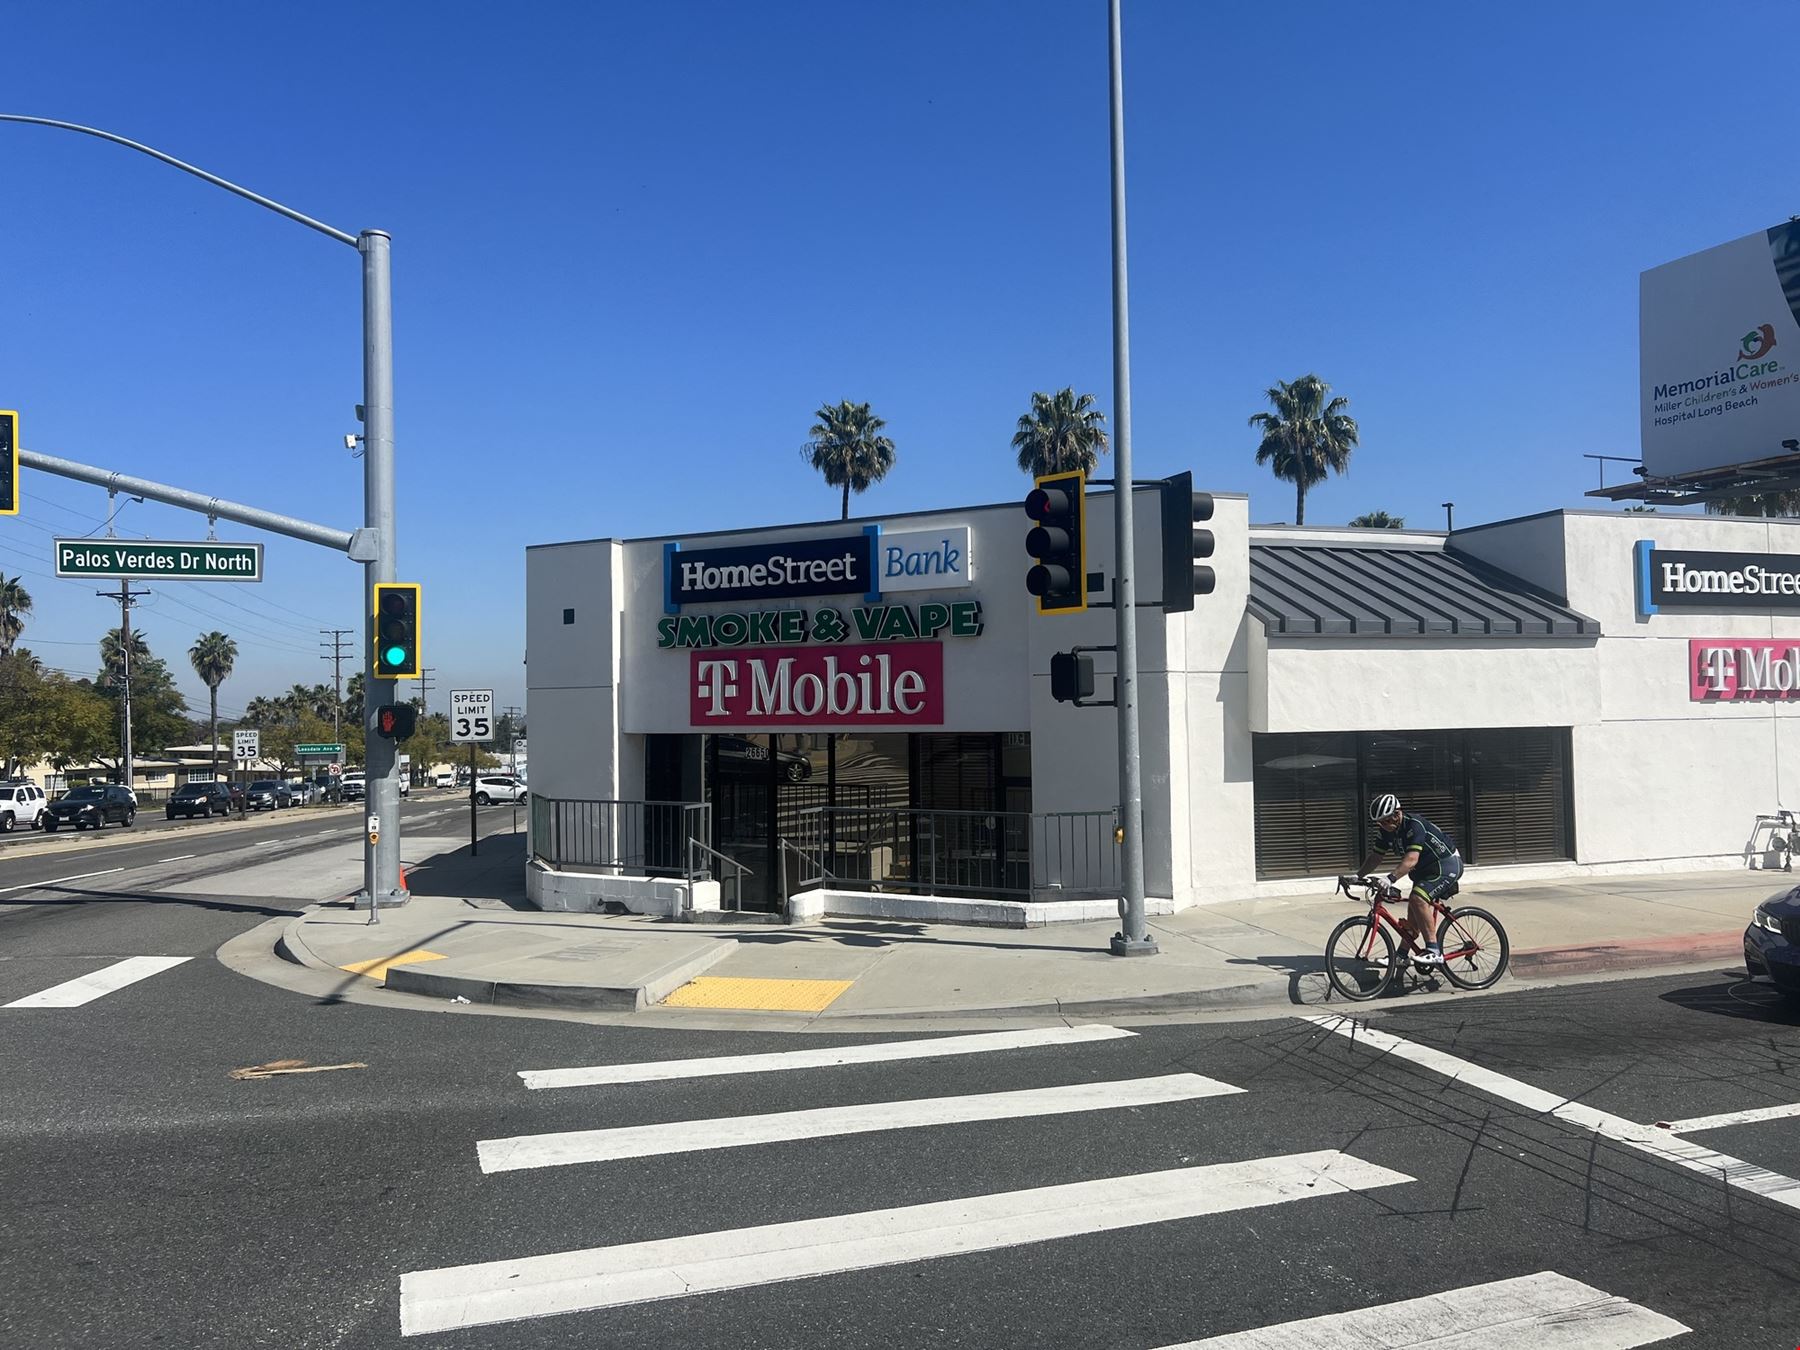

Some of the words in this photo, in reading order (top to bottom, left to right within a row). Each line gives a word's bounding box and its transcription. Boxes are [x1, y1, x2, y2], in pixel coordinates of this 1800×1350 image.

[1653, 360, 1779, 400] MemorialCare
[1654, 401, 1683, 414] Miller
[1684, 388, 1738, 408] Children's
[1738, 384, 1749, 395] &
[1749, 373, 1800, 391] Women's
[1654, 409, 1697, 427] Hospital
[1697, 404, 1723, 418] Long
[1725, 396, 1759, 411] Beach
[62, 549, 111, 568] Palos
[115, 550, 175, 569] Verdes
[180, 552, 200, 570] Dr
[205, 552, 252, 571] North
[681, 553, 857, 592] HomeStreet
[884, 540, 960, 578] Bank
[657, 608, 811, 649] SMOKE
[811, 607, 849, 642] &
[851, 600, 985, 642] VAPE
[453, 694, 490, 703] SPEED
[745, 653, 927, 717] Mobile
[457, 706, 486, 715] LIMIT
[456, 717, 490, 737] 35
[236, 745, 257, 757] 35
